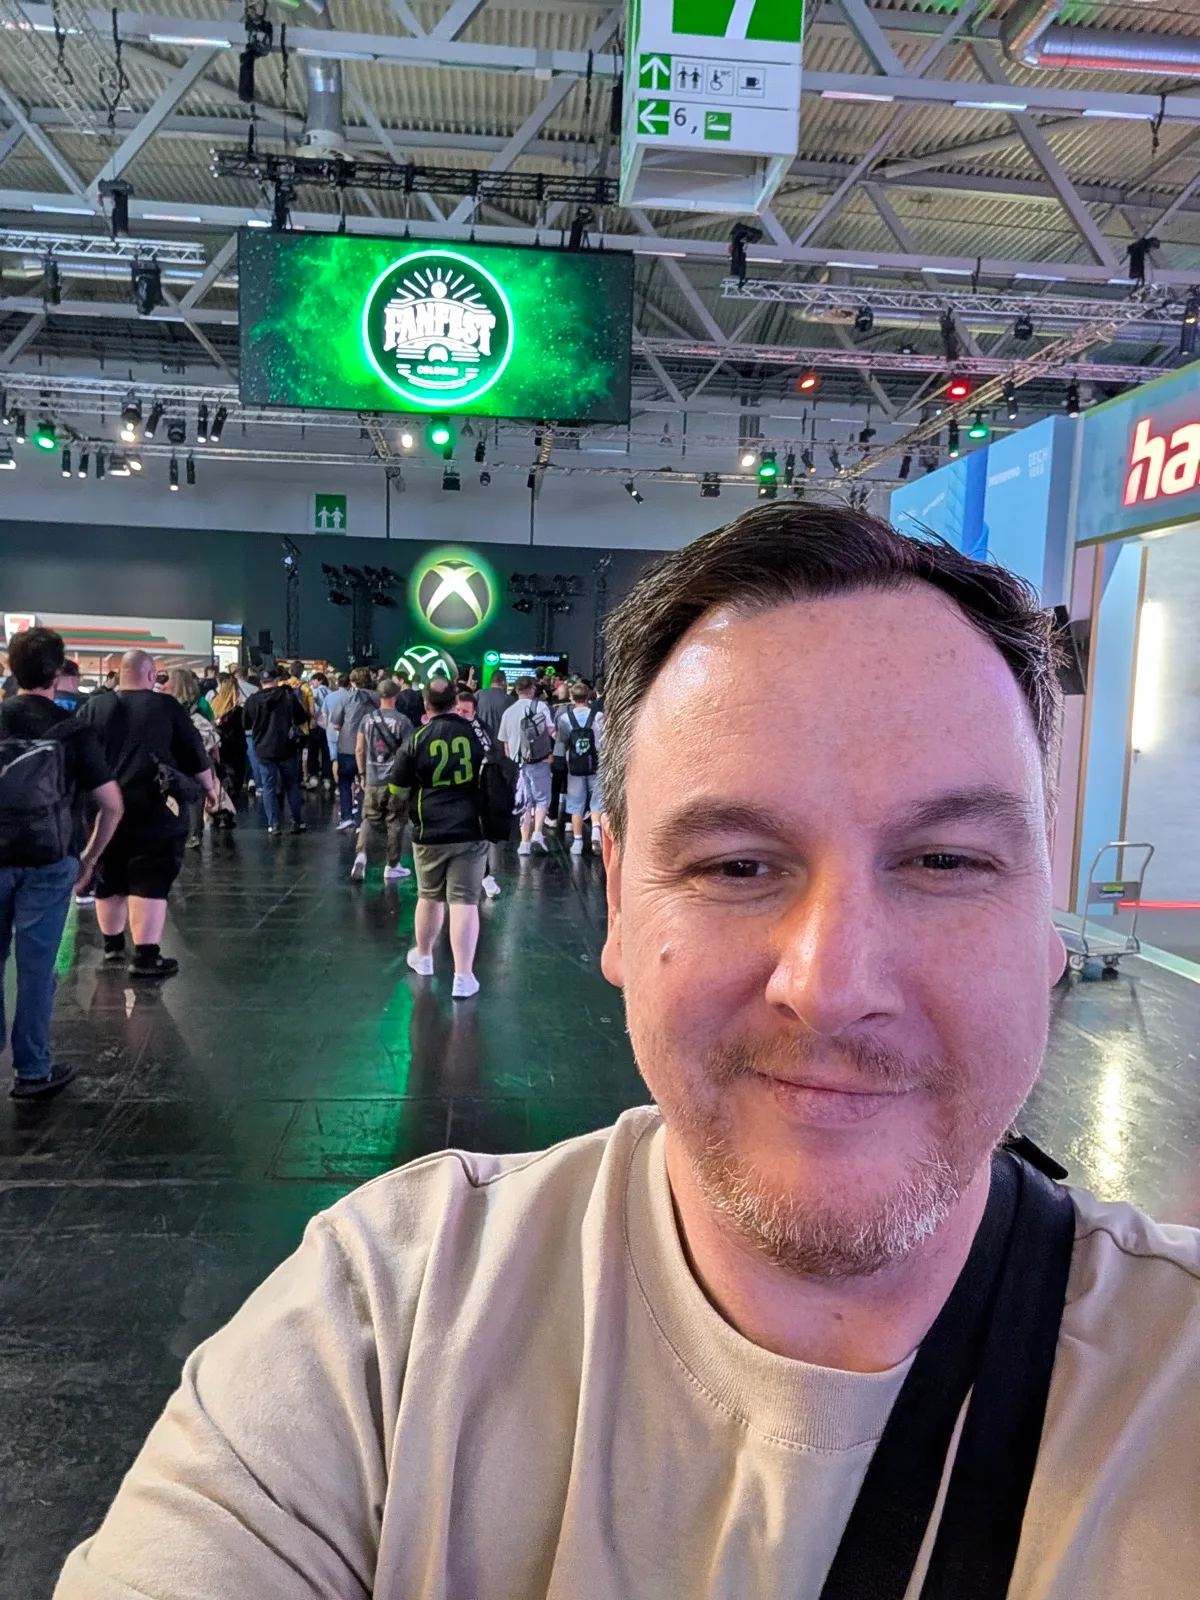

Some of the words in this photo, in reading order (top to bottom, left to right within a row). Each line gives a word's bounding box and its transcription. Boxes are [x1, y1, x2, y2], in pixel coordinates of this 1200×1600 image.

[383, 301, 497, 357] FANFEST
[1123, 417, 1200, 507] ha
[429, 735, 474, 787] 23
